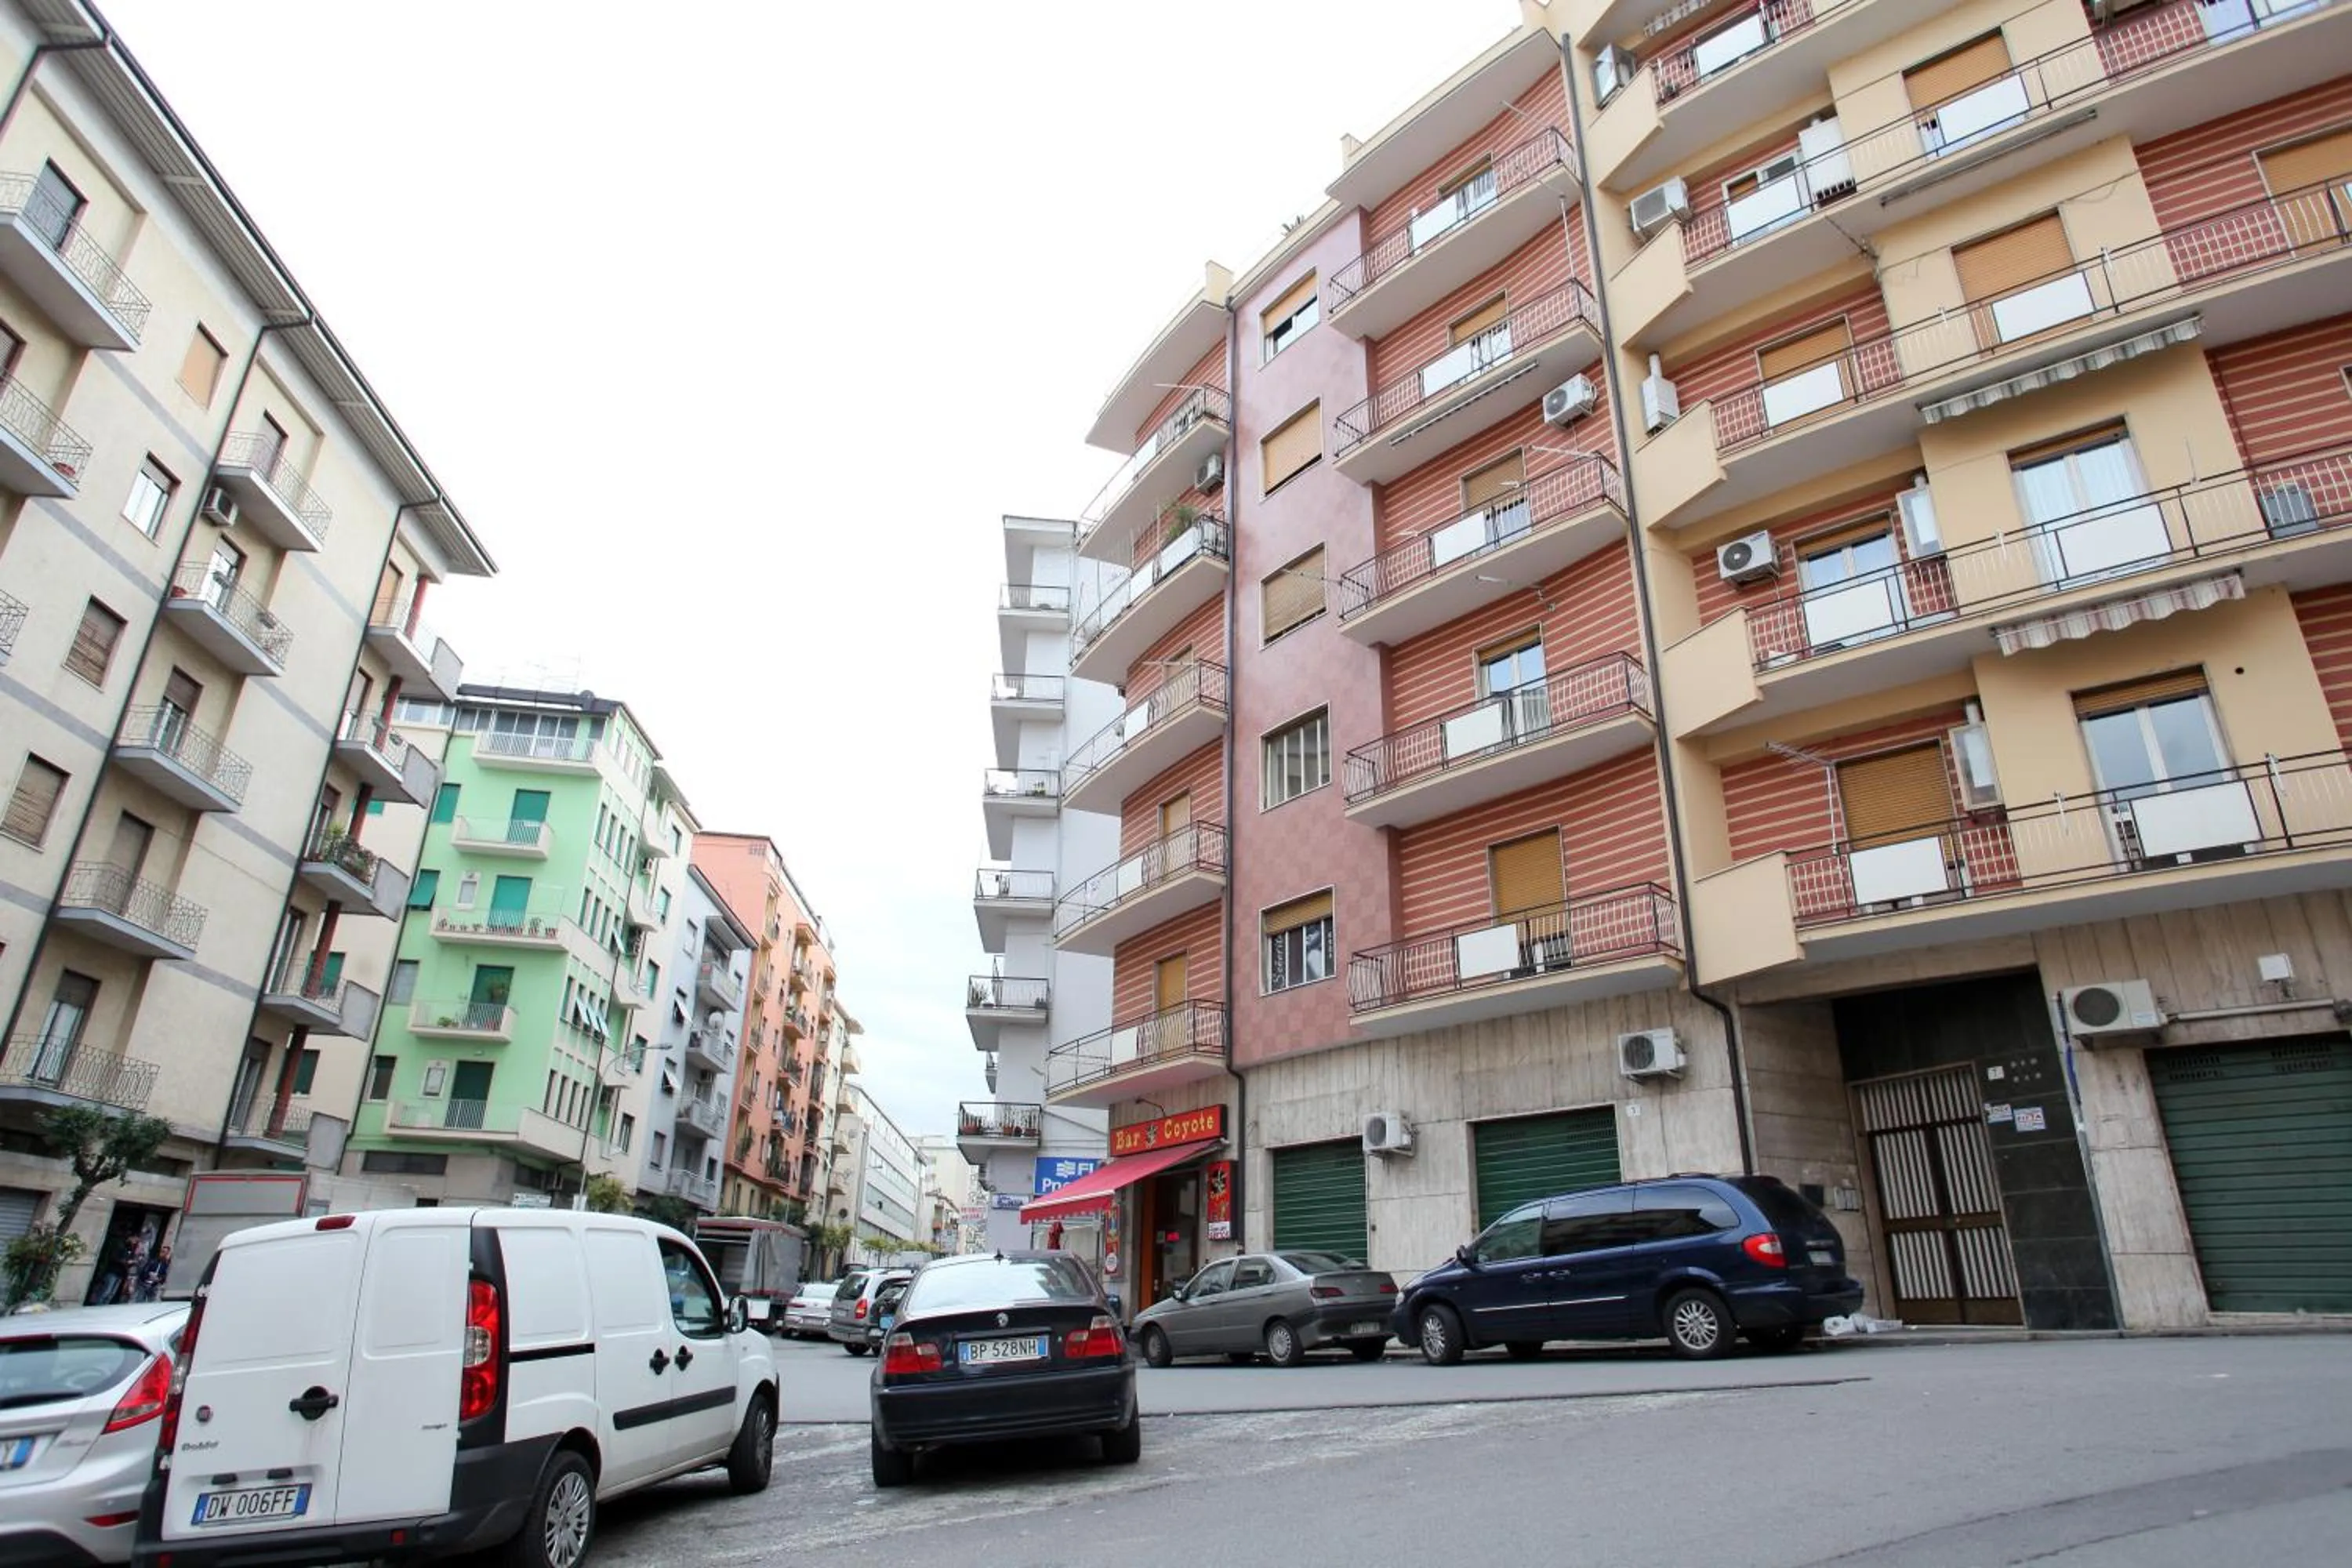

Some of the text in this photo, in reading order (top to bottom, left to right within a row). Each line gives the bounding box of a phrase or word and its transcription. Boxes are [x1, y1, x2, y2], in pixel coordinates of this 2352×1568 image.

[1116, 1111, 1214, 1150] Bar Coyote
[970, 1339, 1036, 1359] BP 528NH
[206, 1489, 296, 1519] DW 006FF
